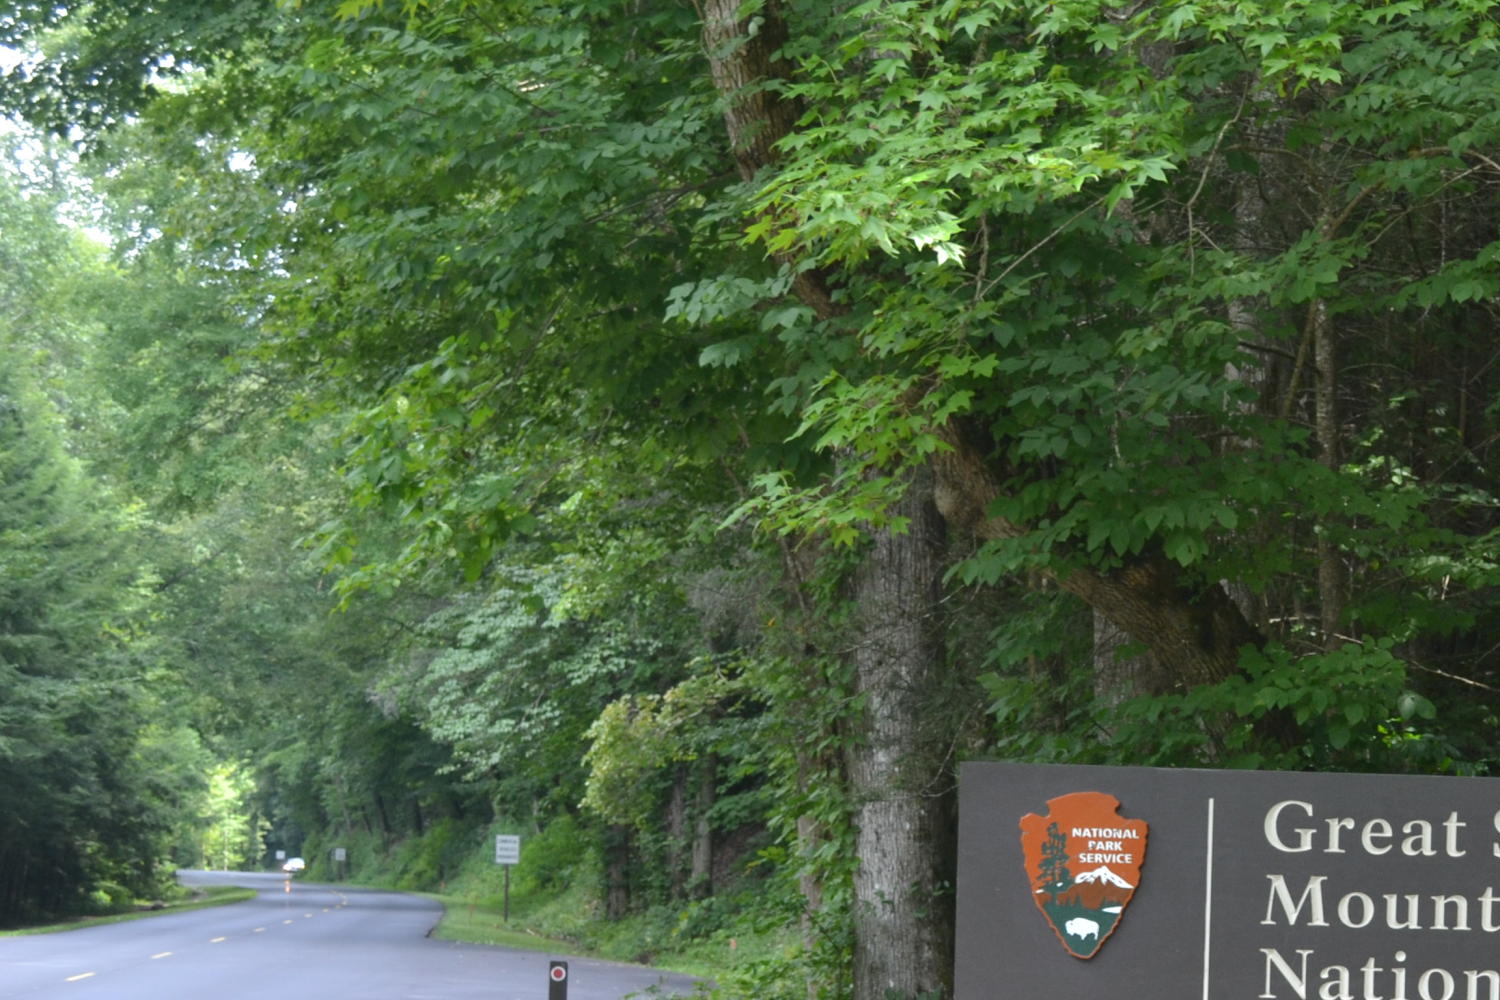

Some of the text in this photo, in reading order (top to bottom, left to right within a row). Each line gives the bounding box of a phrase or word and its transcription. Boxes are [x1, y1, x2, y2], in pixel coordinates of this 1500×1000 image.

[1072, 827, 1139, 839] NATIONAL
[1263, 799, 1467, 858] Great
[1088, 840, 1122, 851] PARK
[1079, 853, 1132, 864] SERVICE
